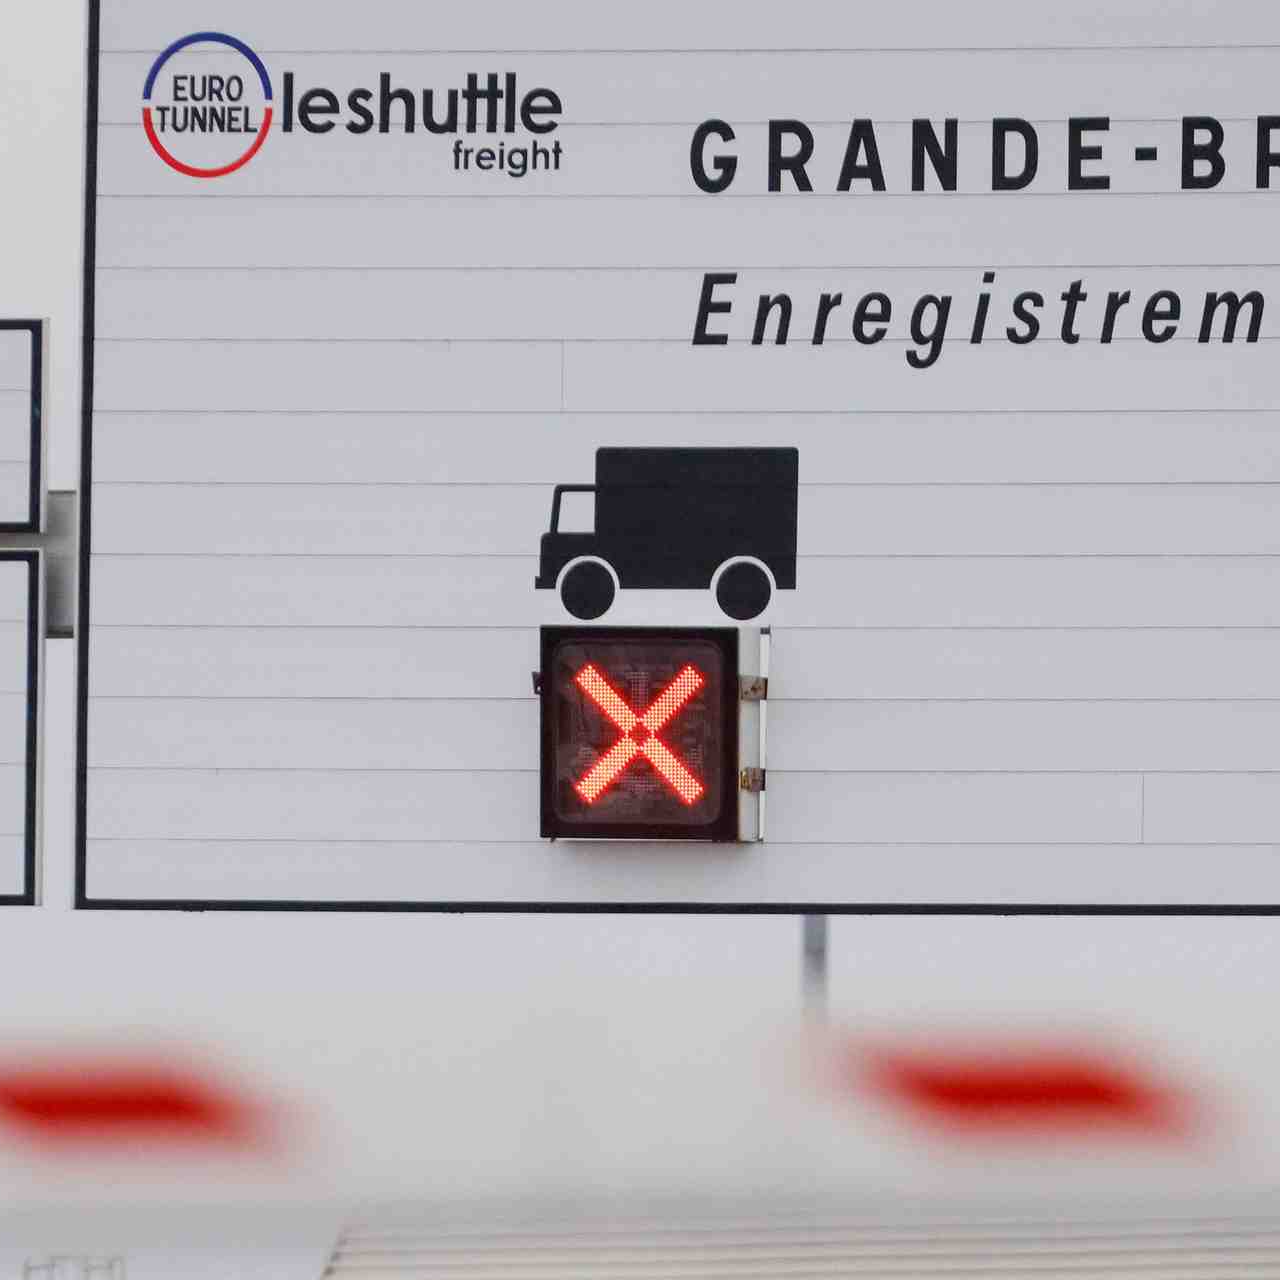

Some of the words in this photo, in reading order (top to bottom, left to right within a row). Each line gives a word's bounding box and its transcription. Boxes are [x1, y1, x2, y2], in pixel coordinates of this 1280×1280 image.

[172, 75, 244, 101] EURO
[282, 72, 563, 134] leshuttle
[156, 106, 258, 133] TUNNEL
[452, 140, 563, 177] freight
